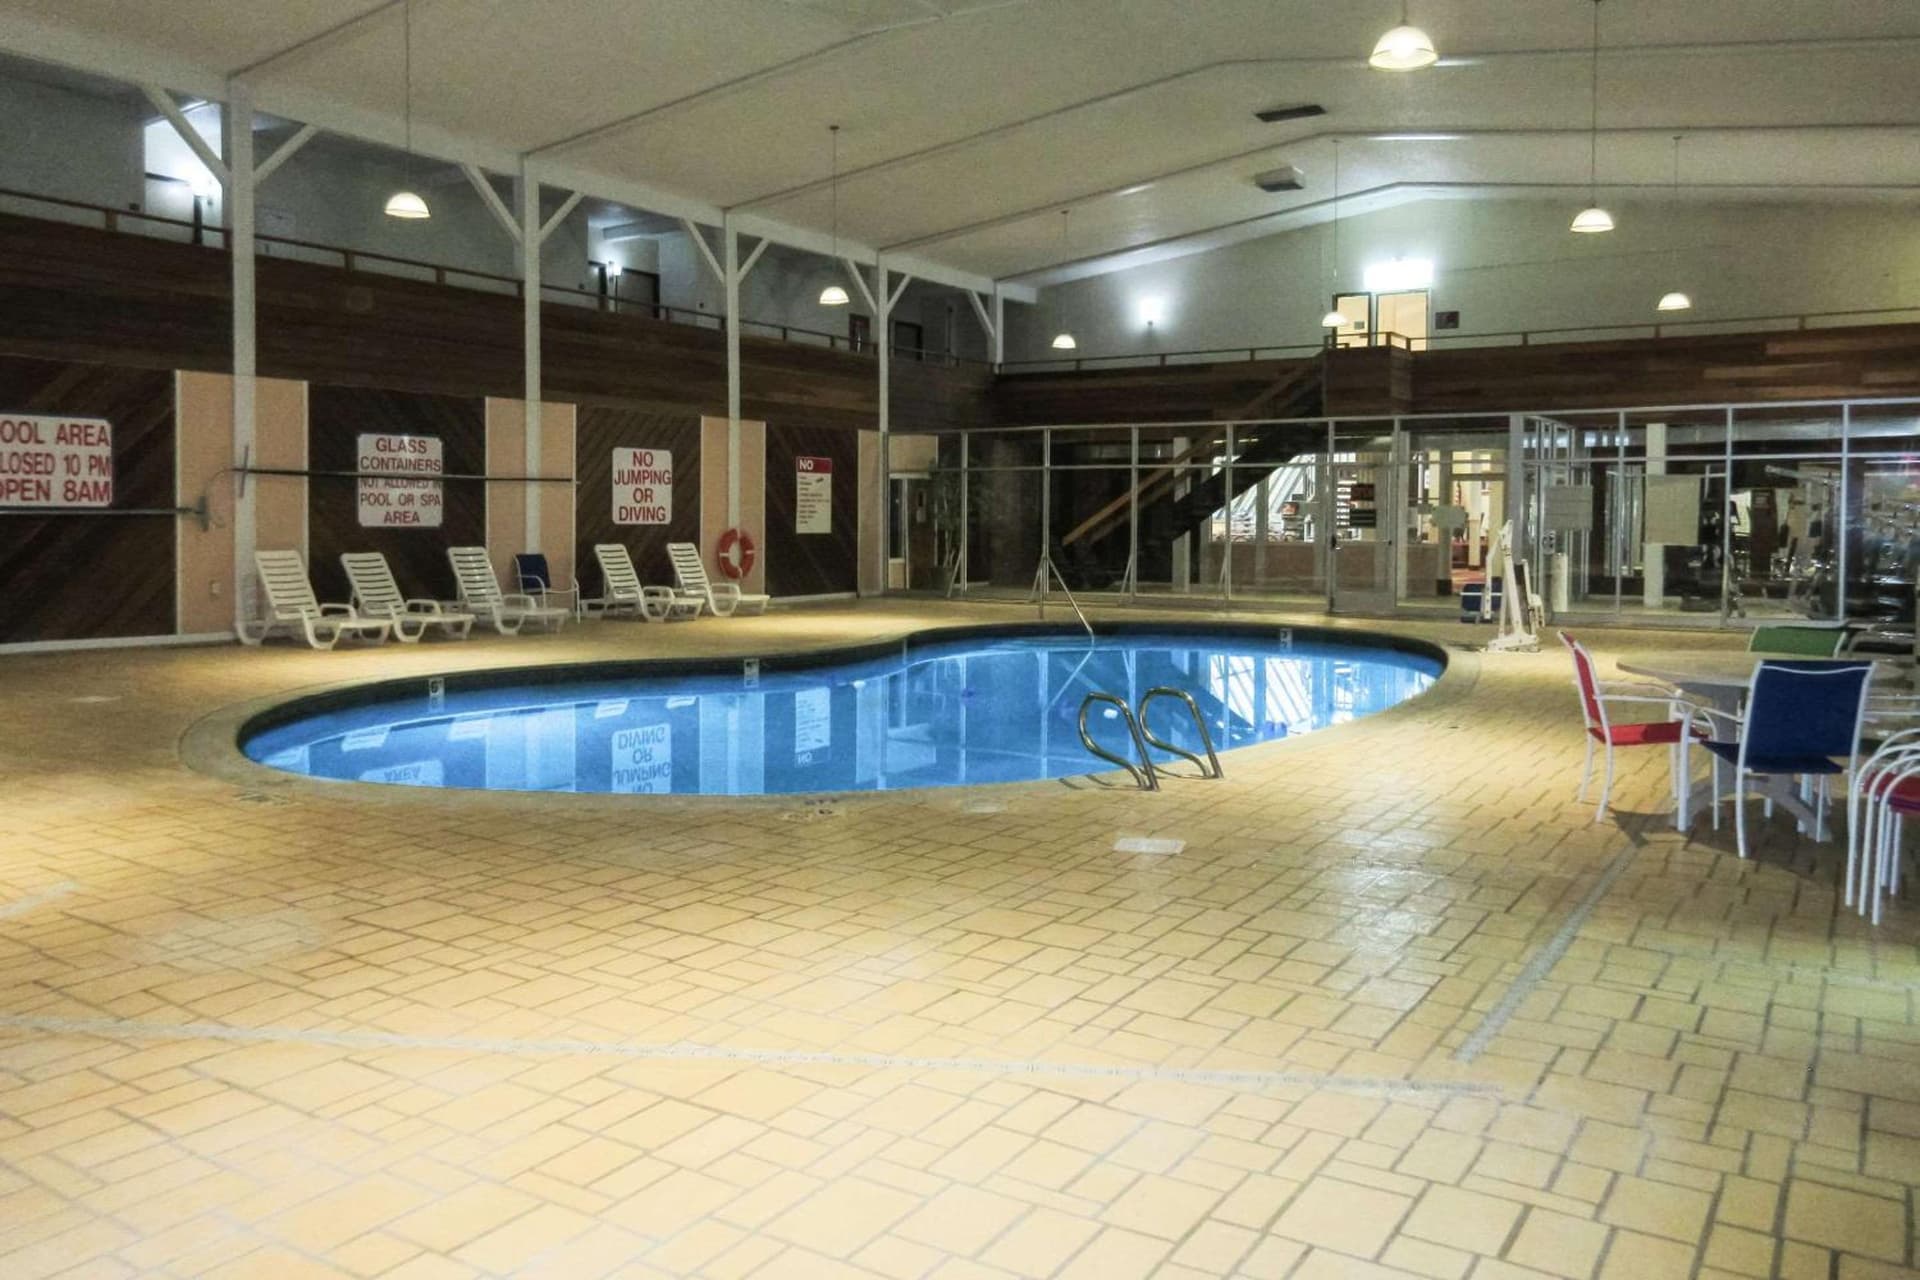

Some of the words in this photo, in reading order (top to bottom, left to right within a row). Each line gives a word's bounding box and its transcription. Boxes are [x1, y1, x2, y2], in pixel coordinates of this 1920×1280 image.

[0, 420, 45, 444] OOL
[56, 423, 109, 446] AREA
[375, 437, 427, 454] GLASS
[0, 452, 55, 475] LOSED
[64, 454, 80, 476] 10
[88, 455, 111, 476] PM
[360, 456, 440, 472] CONTAINERS
[633, 451, 653, 467] NO
[799, 459, 814, 470] NO
[614, 469, 672, 485] JUMPING
[63, 480, 110, 501] 8AM
[633, 488, 653, 503] OR
[360, 493, 392, 506] POOL
[398, 493, 415, 506] OR
[420, 494, 441, 506] SPA
[384, 511, 420, 524] AREA
[619, 506, 666, 521] DIVING
